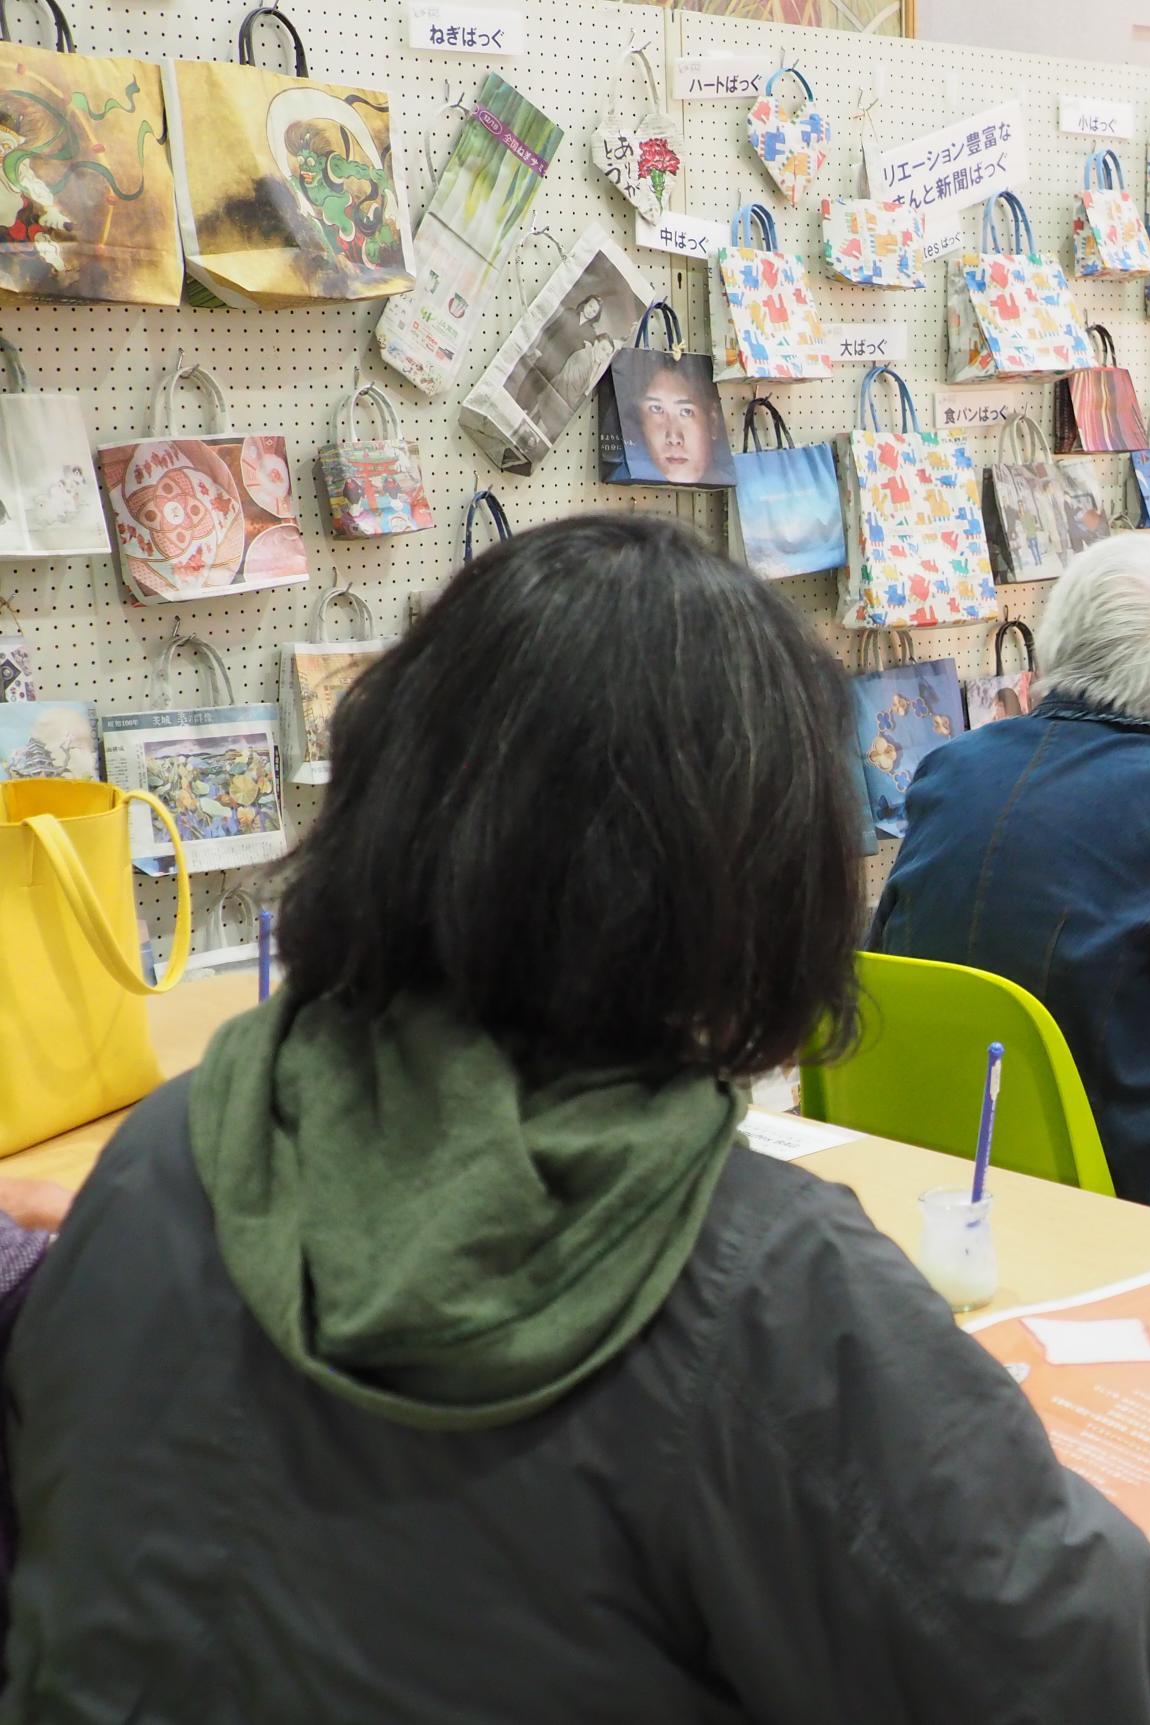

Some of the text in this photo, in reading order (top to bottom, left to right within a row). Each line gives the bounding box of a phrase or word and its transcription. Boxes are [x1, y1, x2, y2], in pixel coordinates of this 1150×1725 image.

[429, 23, 505, 48] ねぎばっぐ
[689, 74, 762, 93] ハートばっぐ
[1078, 114, 1117, 134] 小ばっぐ
[883, 121, 1012, 188] リエーション豊富な
[660, 227, 710, 254] 中ばっぐ
[840, 338, 888, 357] 大ばっぐ
[943, 404, 1009, 425] 食パンばっぐ
[152, 715, 172, 726] 茨城
